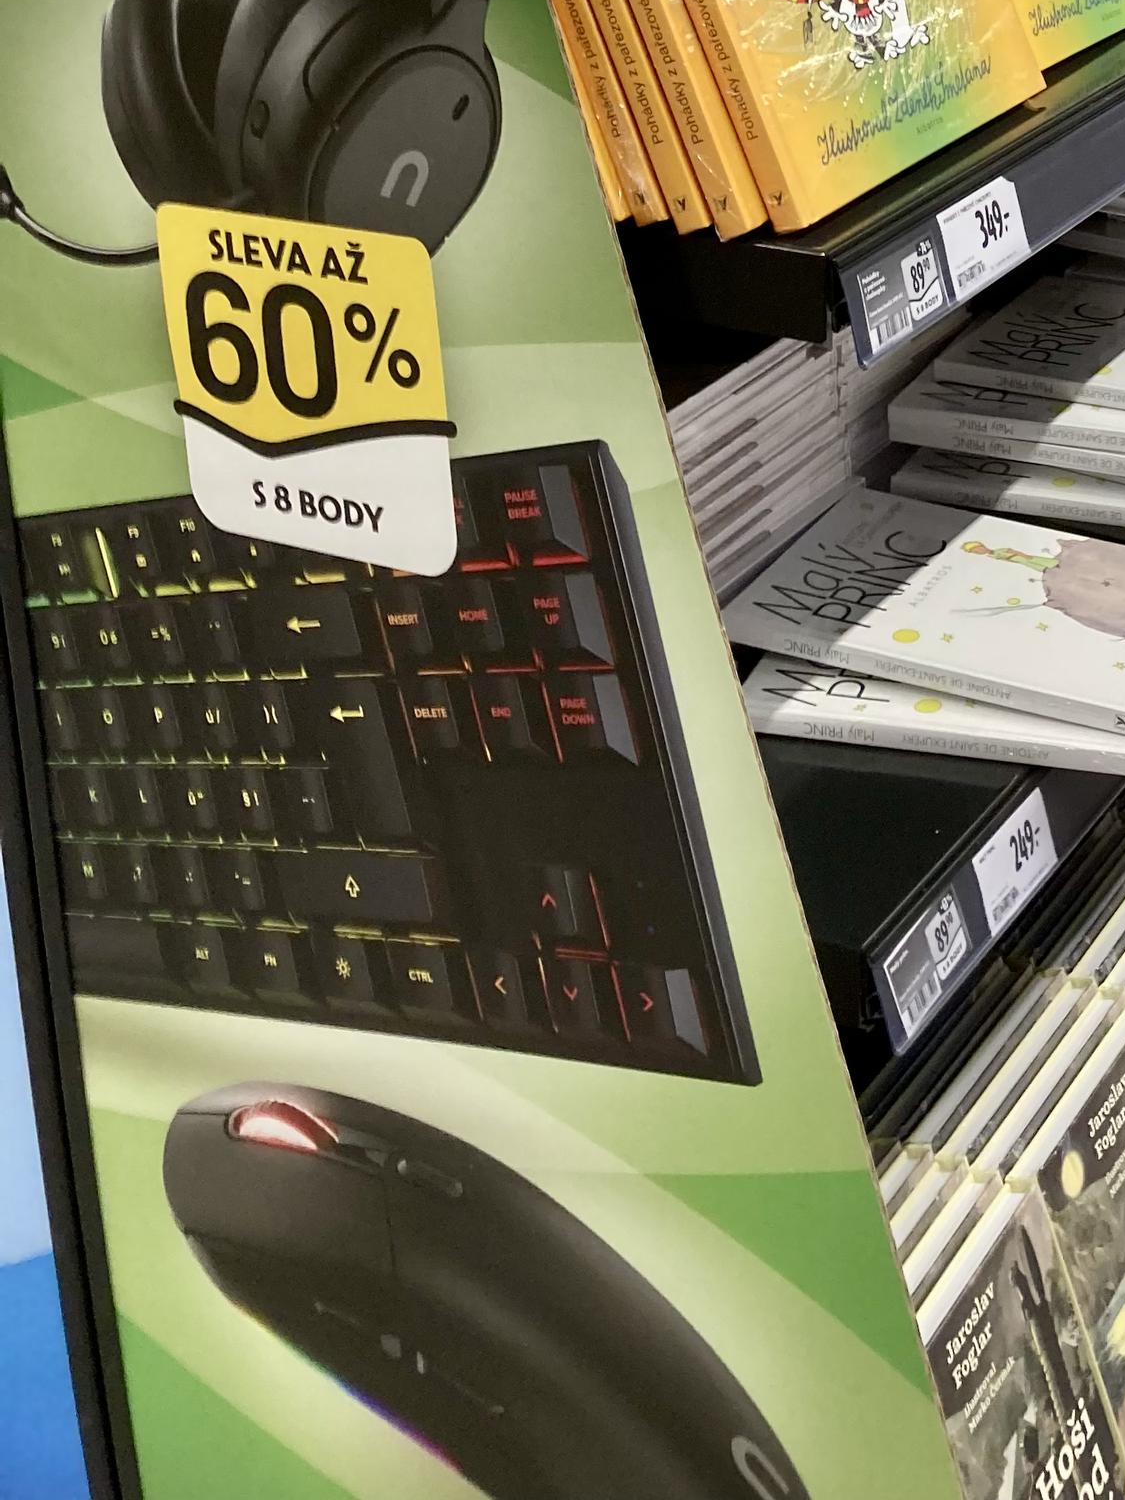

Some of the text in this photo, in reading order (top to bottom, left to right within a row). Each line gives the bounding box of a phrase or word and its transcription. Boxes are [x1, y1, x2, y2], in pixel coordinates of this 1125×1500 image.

[817, 95, 892, 166] Ilustroval
[934, 55, 992, 103] Smetana
[208, 229, 369, 285] SLEVA AŽ
[925, 295, 939, 309] BODY
[969, 311, 1069, 366] Malý
[953, 418, 988, 433] PRINC
[951, 436, 986, 452] PRINC
[503, 489, 539, 503] PAUSE
[251, 481, 385, 534] S 8 BODY
[507, 506, 542, 520] BREAK
[179, 517, 197, 534] F10
[752, 541, 876, 626] Malý
[812, 530, 948, 629] PRINC
[387, 613, 420, 626] INSERT
[458, 608, 489, 622] HOME
[544, 613, 560, 626] UP
[783, 638, 822, 658] PRINC
[949, 676, 963, 690] DE
[965, 681, 1012, 700] ANTOINE
[414, 697, 588, 719] DELETE END PAGE
[561, 712, 595, 726] DOWN
[803, 722, 845, 739] PRINC
[983, 742, 998, 755] DE
[1001, 745, 1049, 762] ANTOINE
[195, 947, 434, 984] ALT FN CTRL
[946, 1281, 997, 1365] Jaroslav
[951, 1320, 994, 1391] Foglar
[967, 1397, 991, 1434] Marko
[1035, 1396, 1096, 1499] Hoši
